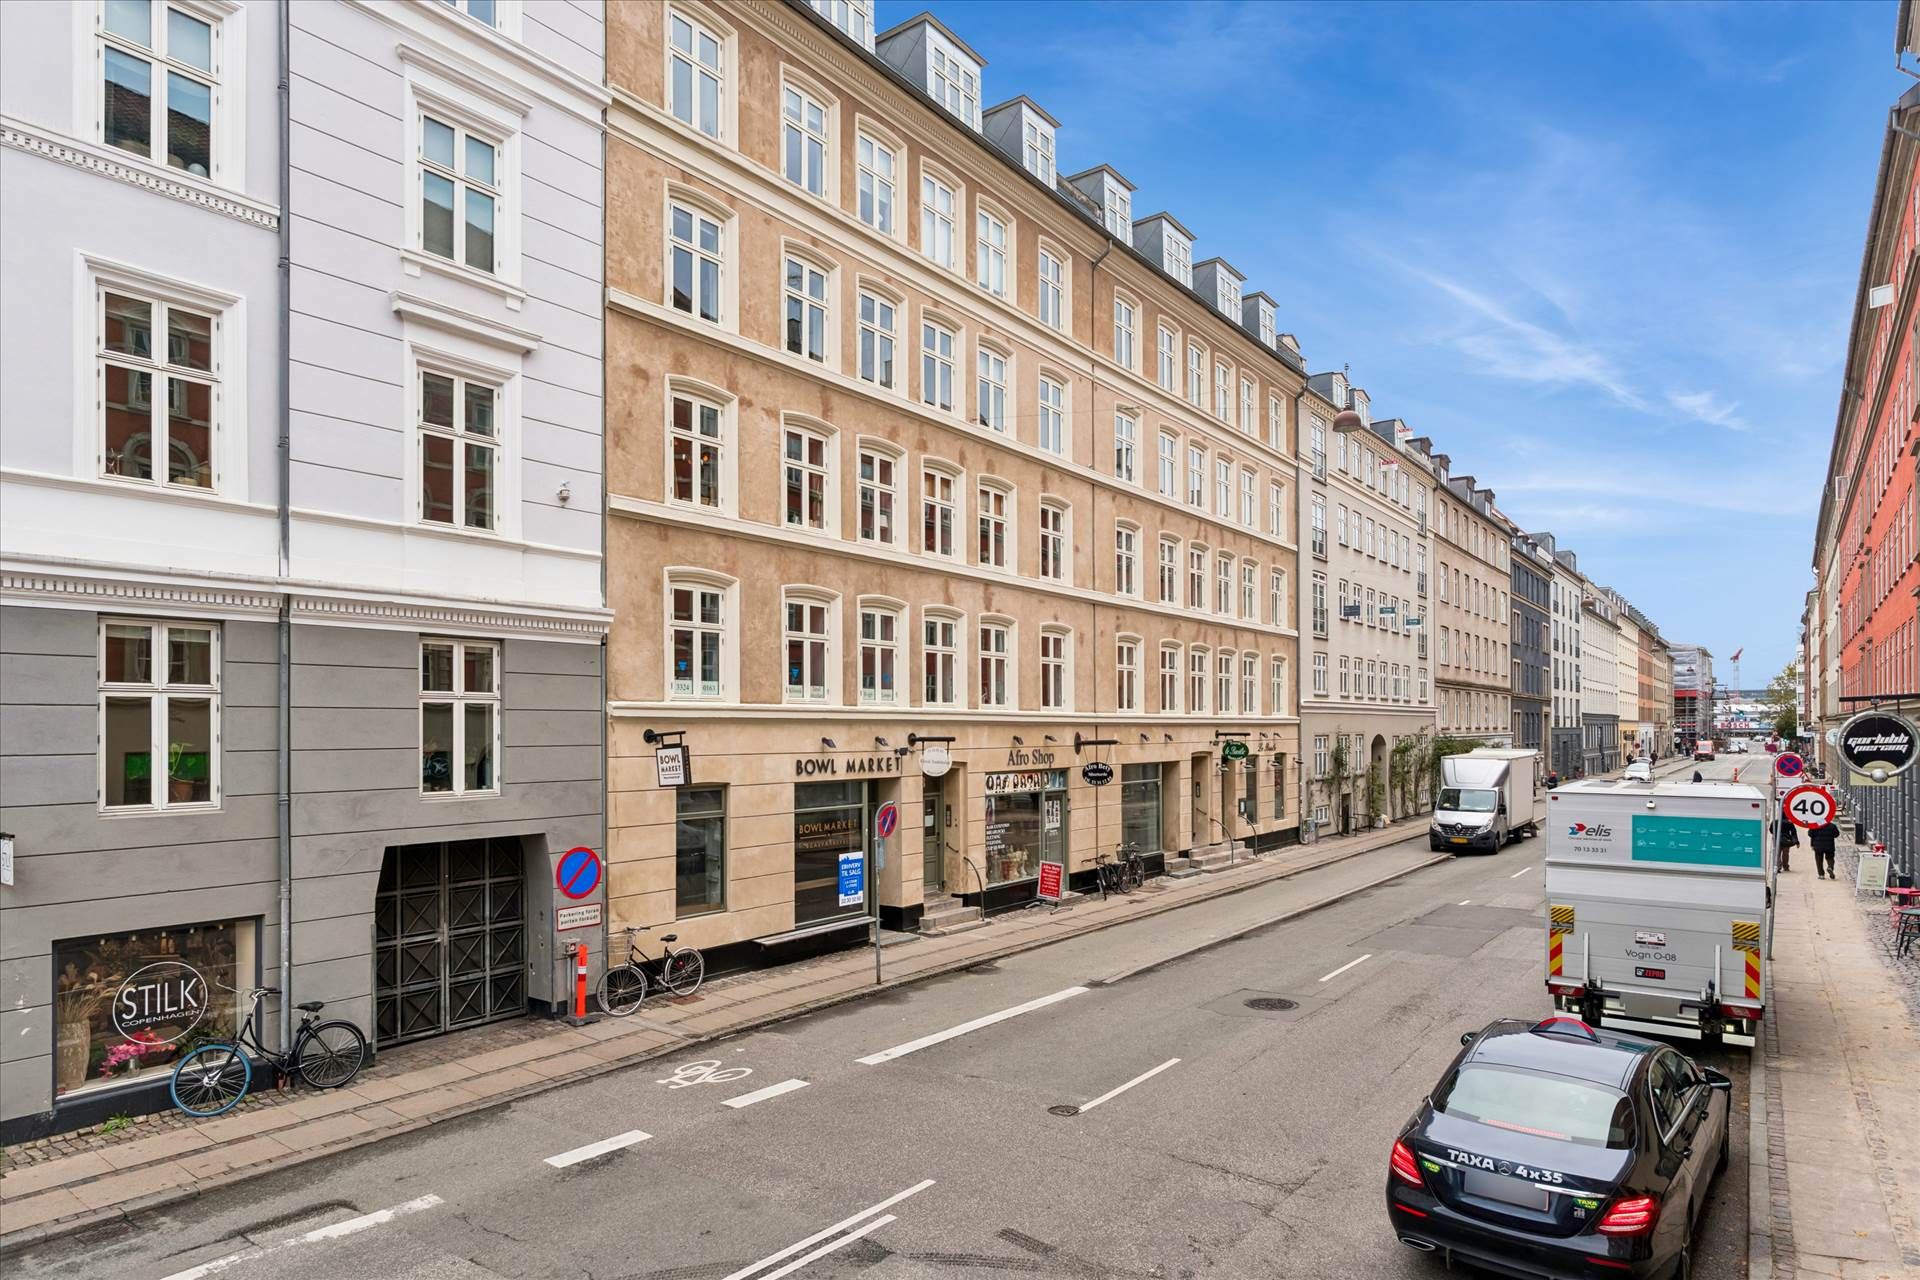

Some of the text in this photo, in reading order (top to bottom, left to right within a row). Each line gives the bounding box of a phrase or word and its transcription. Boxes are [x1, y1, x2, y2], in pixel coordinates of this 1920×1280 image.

[659, 754, 681, 765] BOWL
[796, 756, 901, 776] BOWL MARKET
[1007, 748, 1055, 768] Afro Shop
[660, 764, 681, 773] MARKET
[1792, 799, 1826, 816] 40
[1585, 824, 1612, 837] elis
[1625, 948, 1651, 960] Vogn
[121, 977, 199, 1020] STILK
[121, 1009, 200, 1028] COPENHAGEN
[1447, 1148, 1564, 1185] TAXA 4x35
